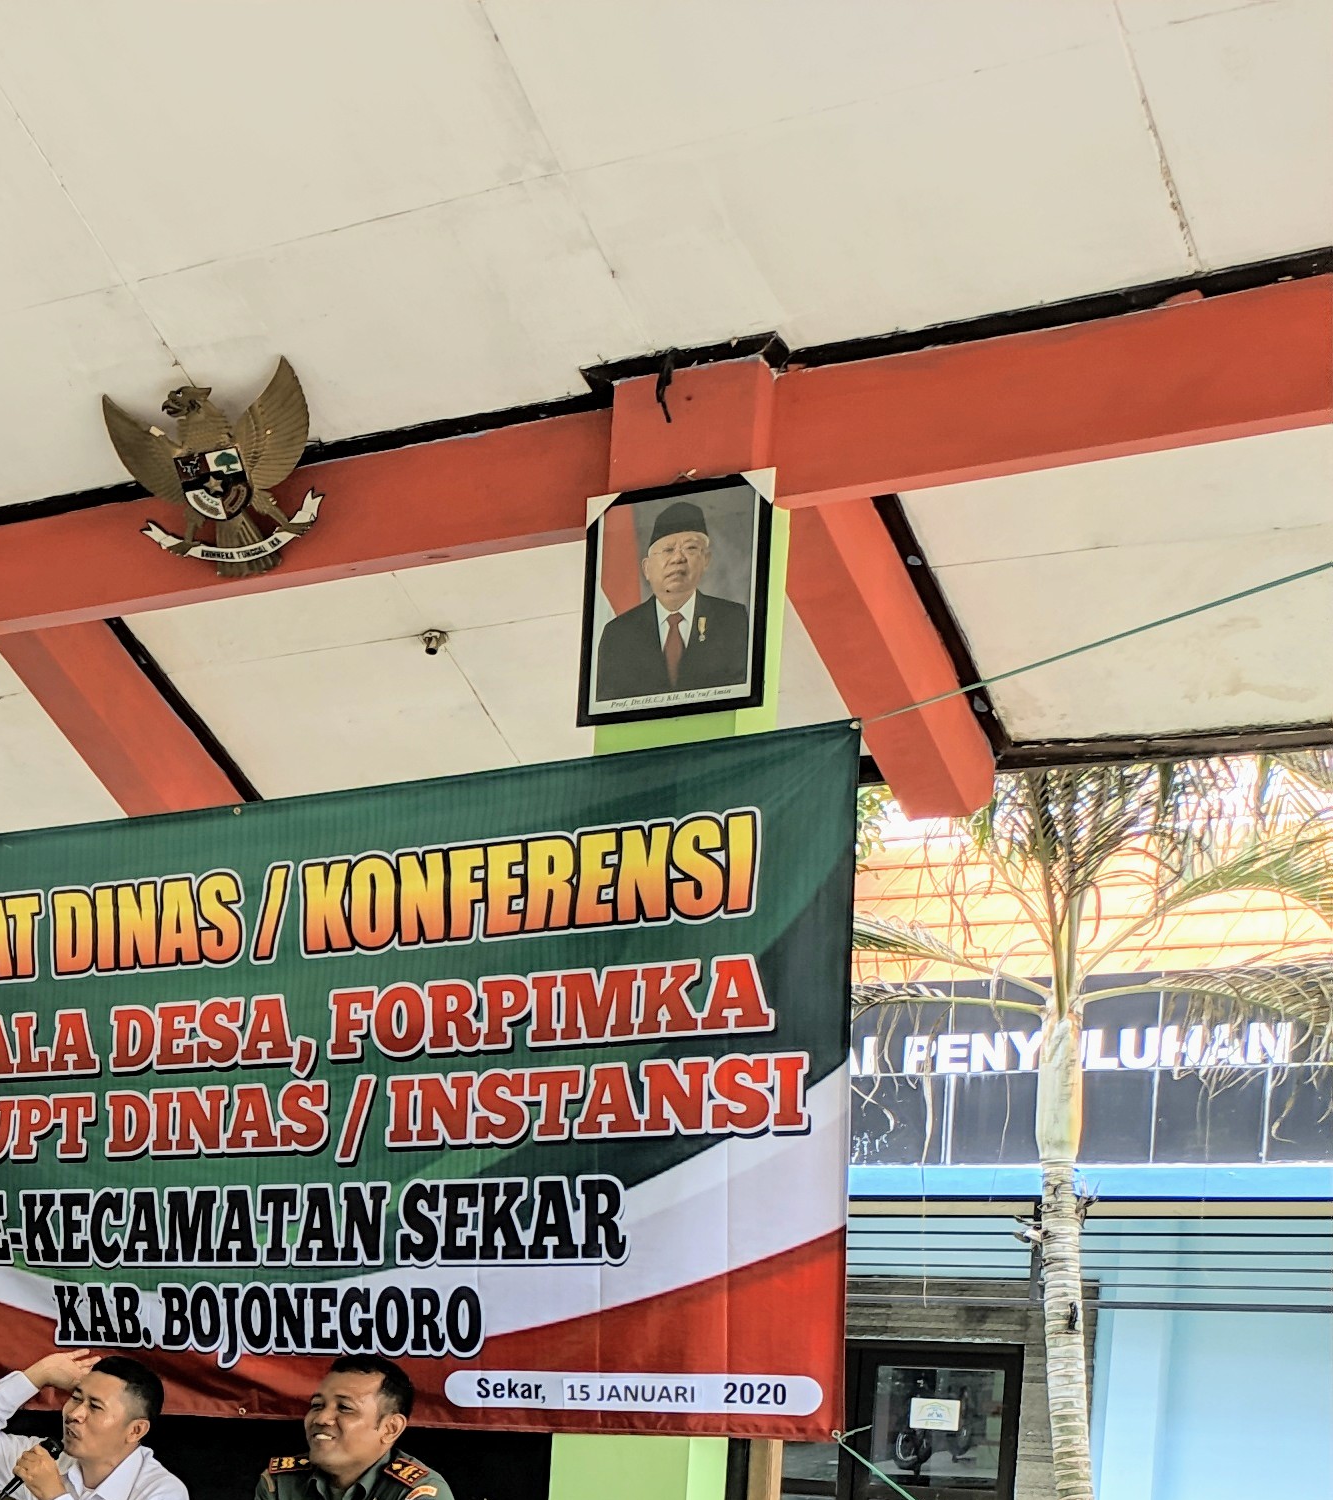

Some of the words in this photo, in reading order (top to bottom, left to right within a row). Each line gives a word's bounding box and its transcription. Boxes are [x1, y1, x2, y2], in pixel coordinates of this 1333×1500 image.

[51, 872, 244, 977] DINAS
[253, 864, 291, 961] /
[302, 810, 758, 954] KONFERENSI
[111, 996, 316, 1077] DESA,
[329, 956, 773, 1057] FORPIMKA
[902, 1021, 1293, 1074] PENYLUHAN
[105, 1079, 328, 1158] DINAS
[335, 1075, 376, 1164] /
[386, 1052, 809, 1149] INSTANSI
[398, 1176, 631, 1266] SEKAR
[52, 1283, 153, 1349] KAB.
[160, 1282, 485, 1369] BOJONEGORO
[475, 1376, 547, 1403] Sekar,
[566, 1383, 591, 1402] 15
[596, 1384, 696, 1404] JANUARI
[722, 1381, 788, 1406] 2020
